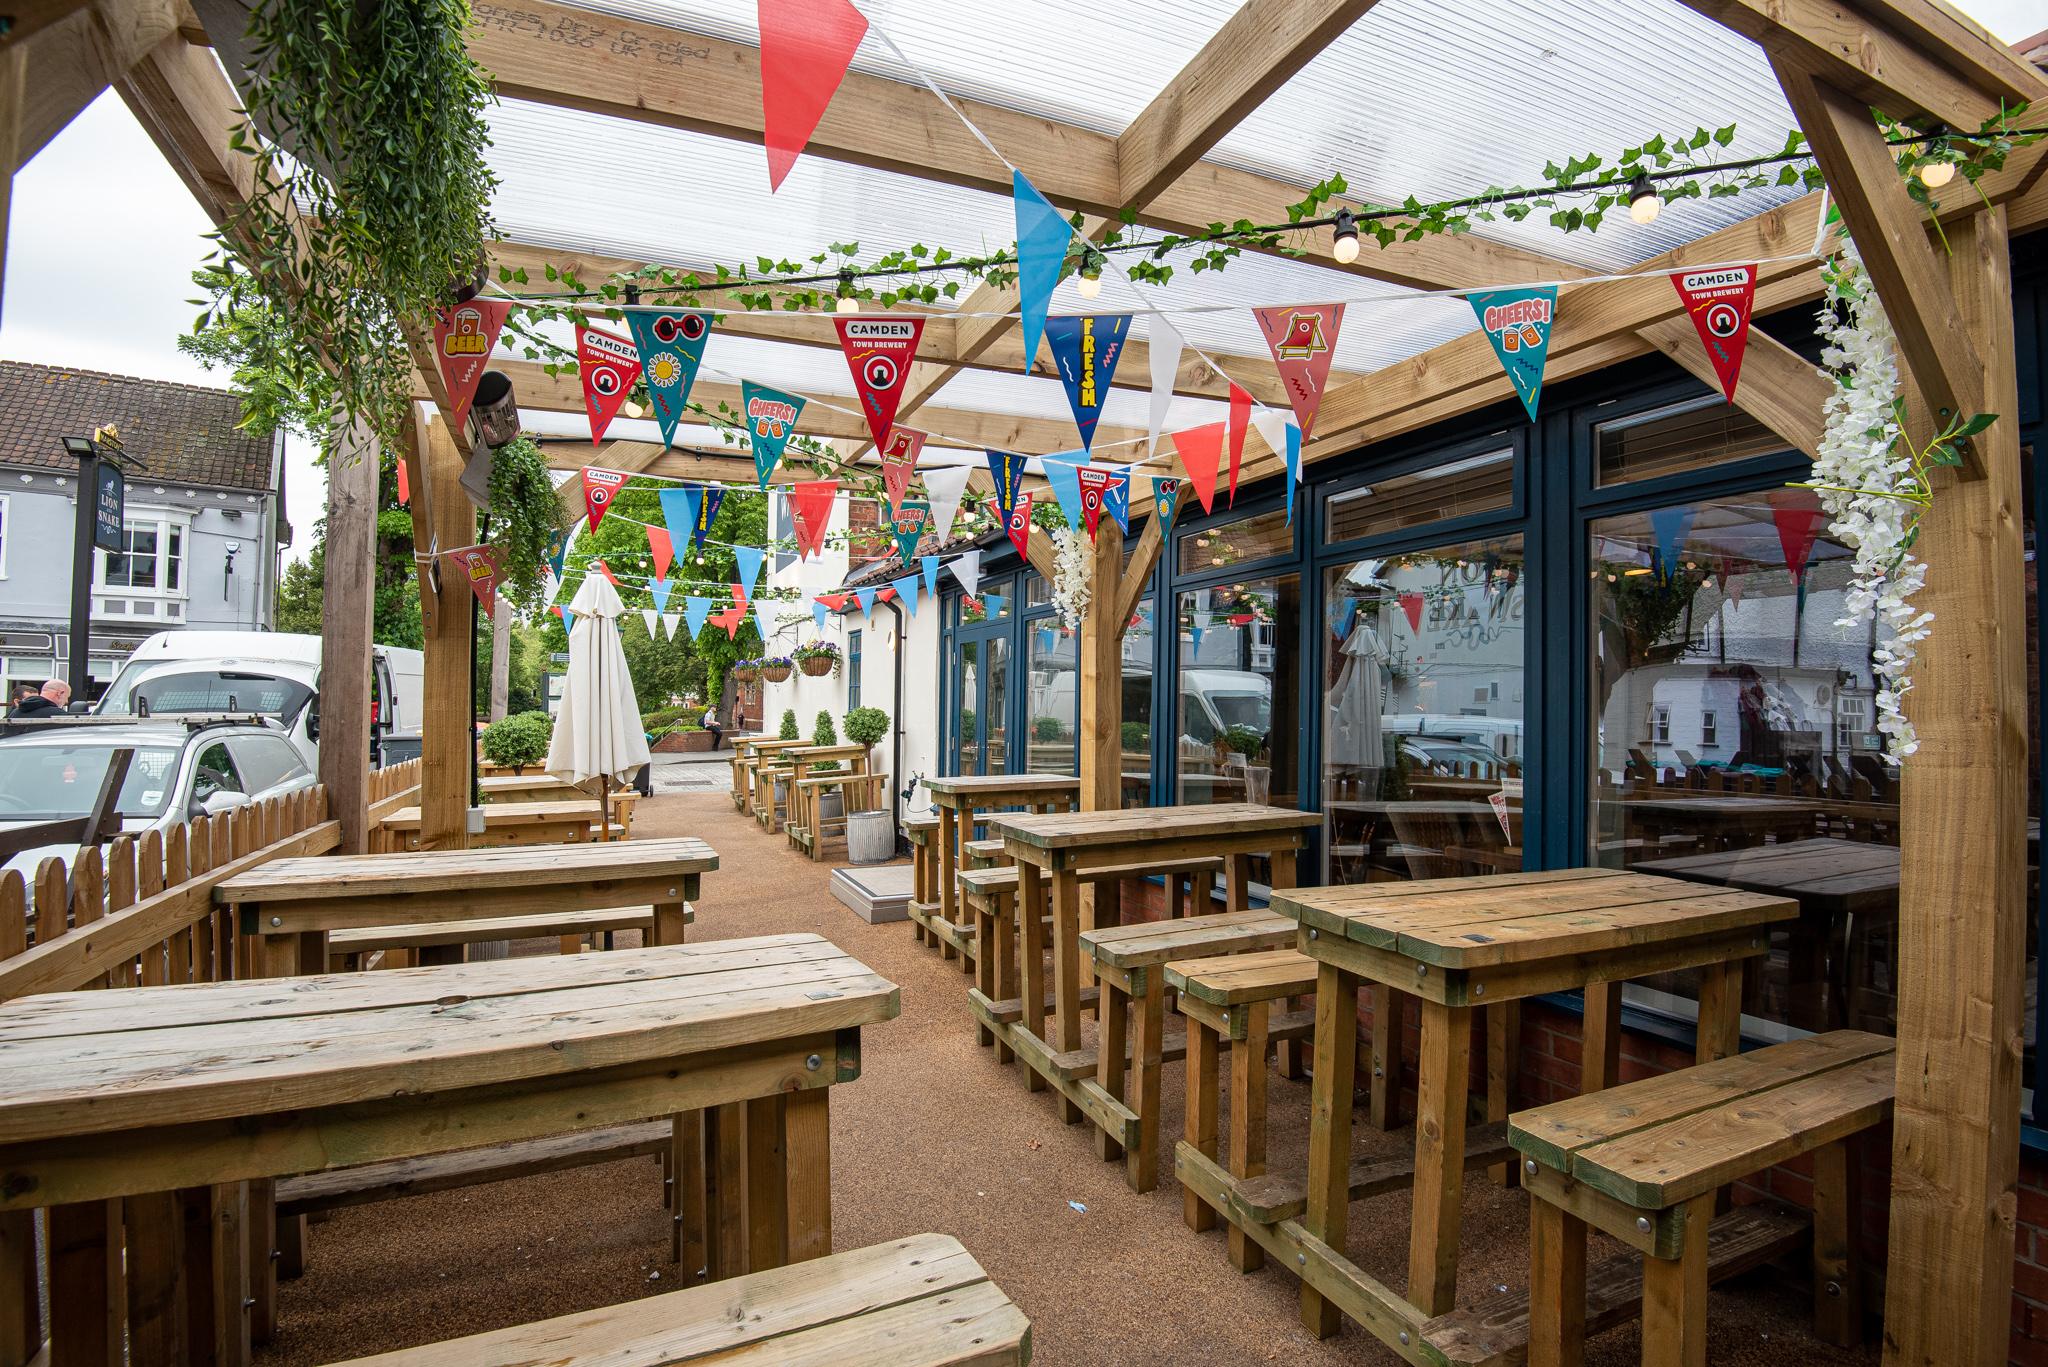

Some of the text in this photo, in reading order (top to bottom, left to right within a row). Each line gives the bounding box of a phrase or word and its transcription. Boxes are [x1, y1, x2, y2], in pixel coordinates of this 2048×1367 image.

[558, 16, 606, 37] Dry
[619, 30, 711, 60] Graded
[1687, 272, 1744, 287] CAMDEN
[1691, 287, 1744, 300] TOWN BREWERY
[1485, 298, 1551, 332] CHEERS!
[850, 325, 909, 335] CAMDEN
[445, 334, 487, 356] BEER
[587, 335, 638, 358] CAMDEN
[874, 341, 907, 349] BREWERY
[586, 347, 634, 369] TOWN BREWERY
[1080, 318, 1096, 407] FRESH
[748, 398, 797, 424] CHEERS!
[589, 471, 619, 481] CAMDEN
[1003, 456, 1013, 511] FRESH
[1082, 472, 1105, 481] CAMDEN
[101, 494, 119, 511] LION
[98, 510, 120, 528] SNAKE
